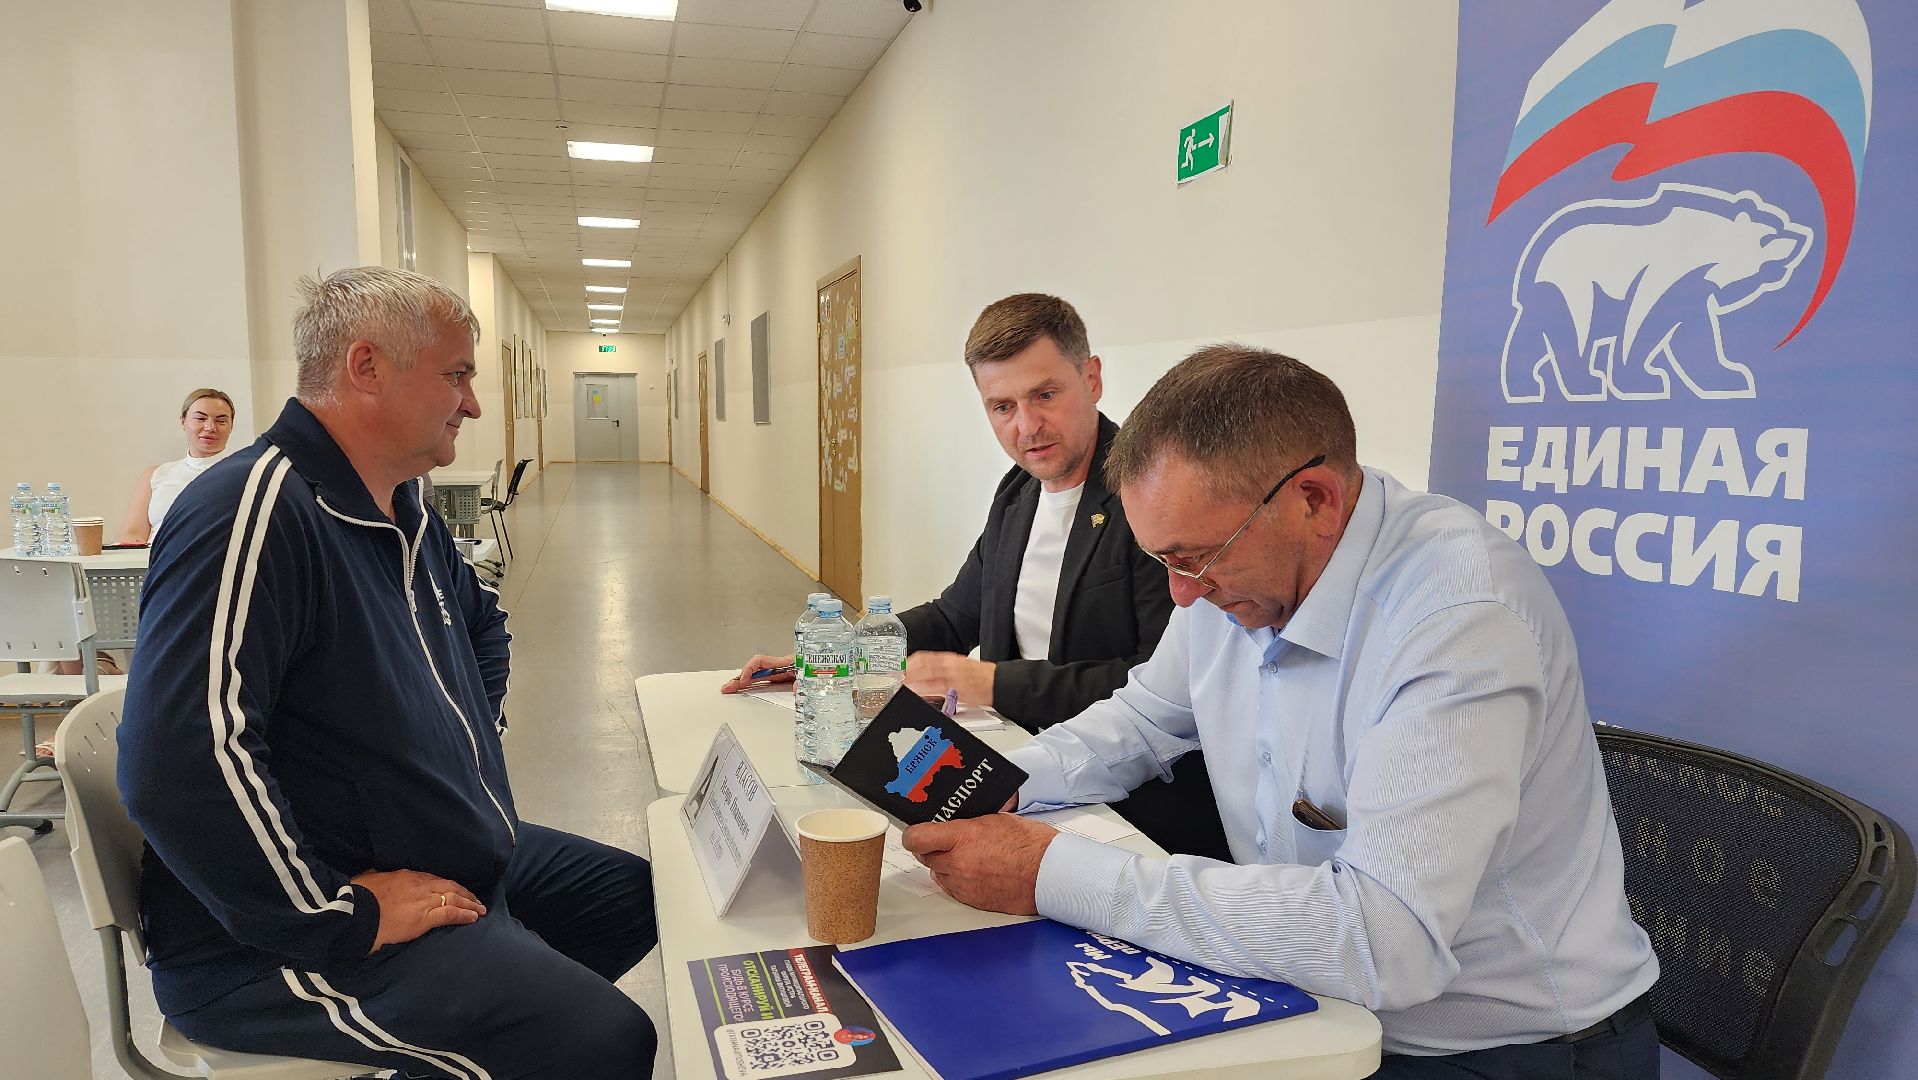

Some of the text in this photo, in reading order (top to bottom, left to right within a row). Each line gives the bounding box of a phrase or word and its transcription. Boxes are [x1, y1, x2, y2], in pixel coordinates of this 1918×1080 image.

[1486, 426, 1809, 500] ЕДИНАЯ
[1485, 499, 1803, 603] РОССИЯ
[735, 760, 759, 802] ВЛАСОВ
[741, 959, 773, 1011] ОТСКАНИРУЙ
